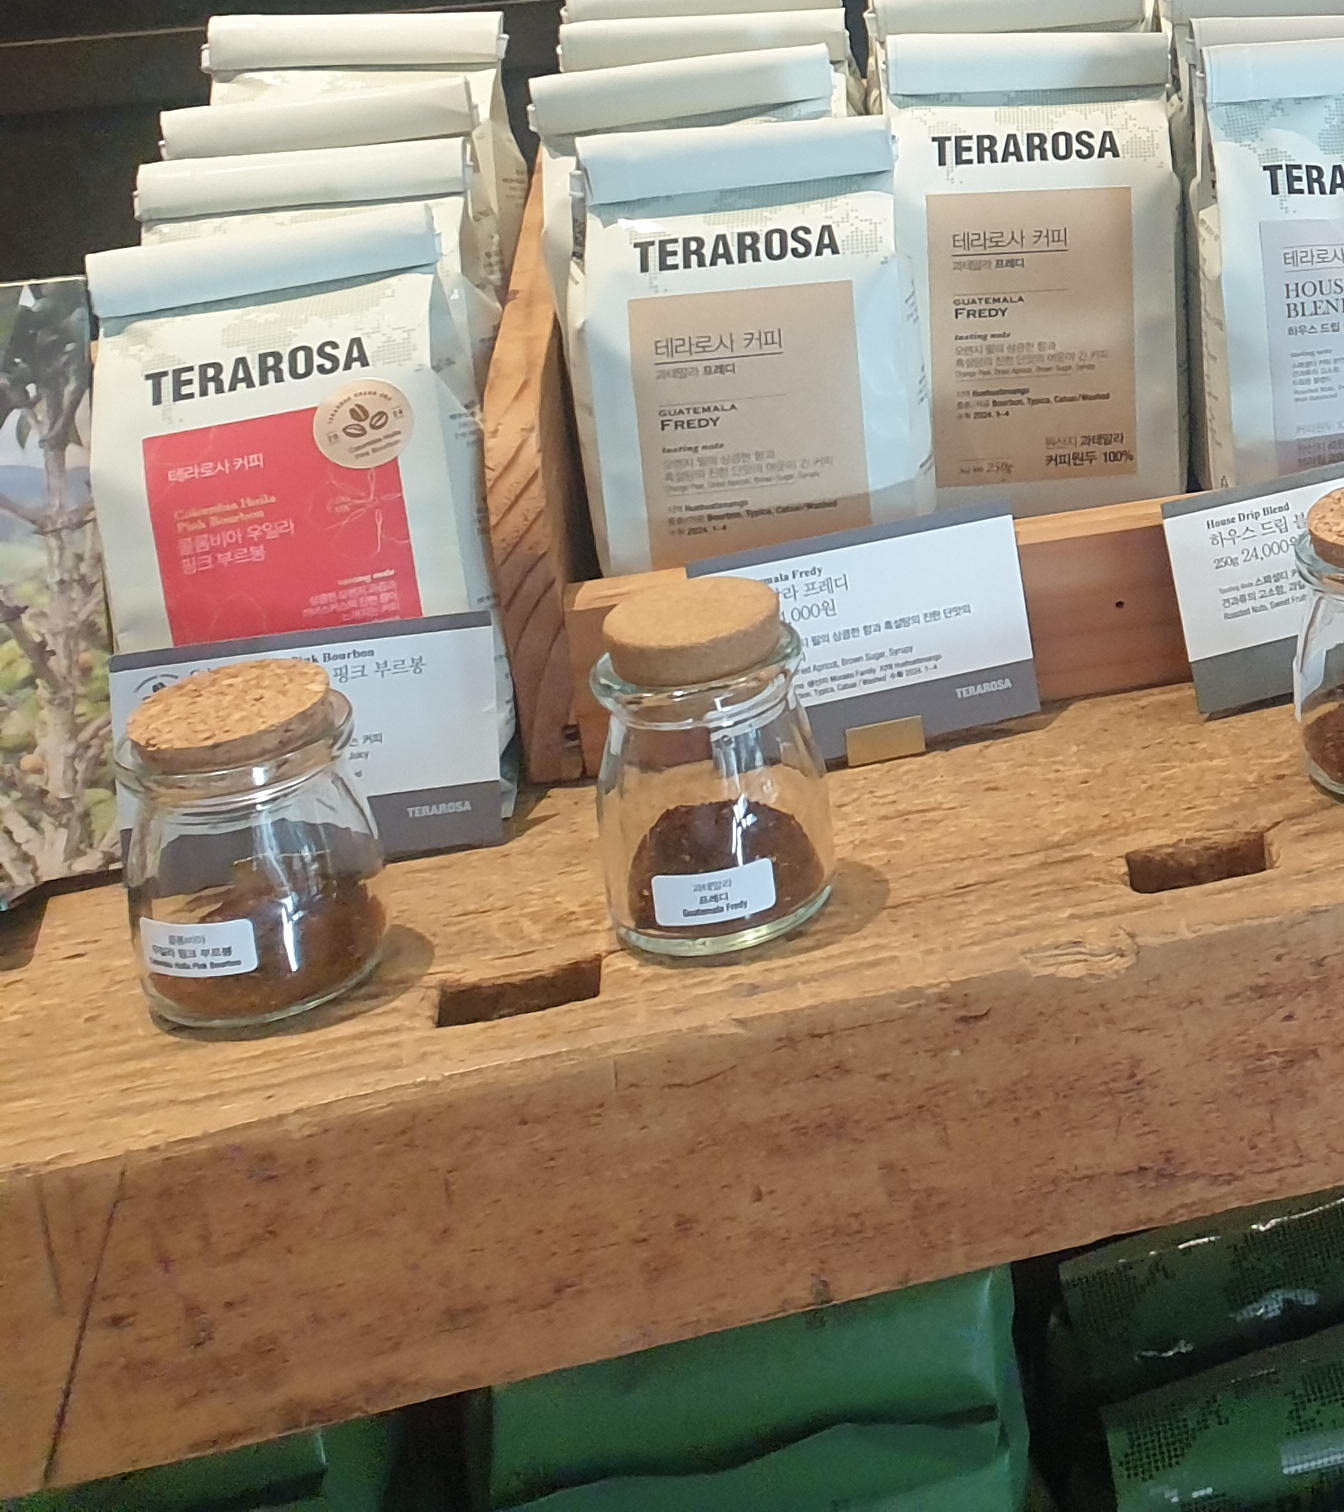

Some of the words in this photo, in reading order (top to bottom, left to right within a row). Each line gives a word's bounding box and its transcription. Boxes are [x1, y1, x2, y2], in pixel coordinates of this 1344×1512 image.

[931, 130, 1120, 167] TERAROSA
[633, 224, 840, 273] TERAROSA
[952, 230, 1024, 250] 테라로사
[1033, 227, 1067, 248] 커피
[953, 296, 1024, 306] GUATEMALA
[955, 308, 1008, 319] FREDY
[1287, 325, 1318, 336] 하우스
[1320, 322, 1340, 333] 드립
[655, 333, 734, 359] 테라로사
[743, 328, 782, 350] 커피
[145, 337, 370, 406] TERAROSA
[658, 404, 737, 417] GUATEMALA
[660, 417, 720, 431] FREDY
[168, 459, 230, 482] 테라로사
[233, 453, 264, 470] 커피
[1045, 452, 1097, 467] 커피원두
[1102, 451, 1133, 463] 100%
[1206, 516, 1236, 530] House
[1238, 510, 1260, 524] Drip
[1262, 502, 1290, 517] Blend
[1210, 526, 1258, 548] 하우스
[1261, 517, 1288, 538] 드립
[792, 565, 823, 580] Fredy
[1213, 555, 1239, 570] 250g
[803, 574, 849, 597] 프레디
[833, 629, 860, 642] 상큼한
[884, 615, 920, 631] 흑설탕의
[943, 604, 971, 619] 단맛의
[333, 664, 367, 684] 핑크
[956, 678, 1012, 698] TERAROSA
[407, 801, 471, 818] TERAROSA
[682, 906, 724, 917] Guatemala
